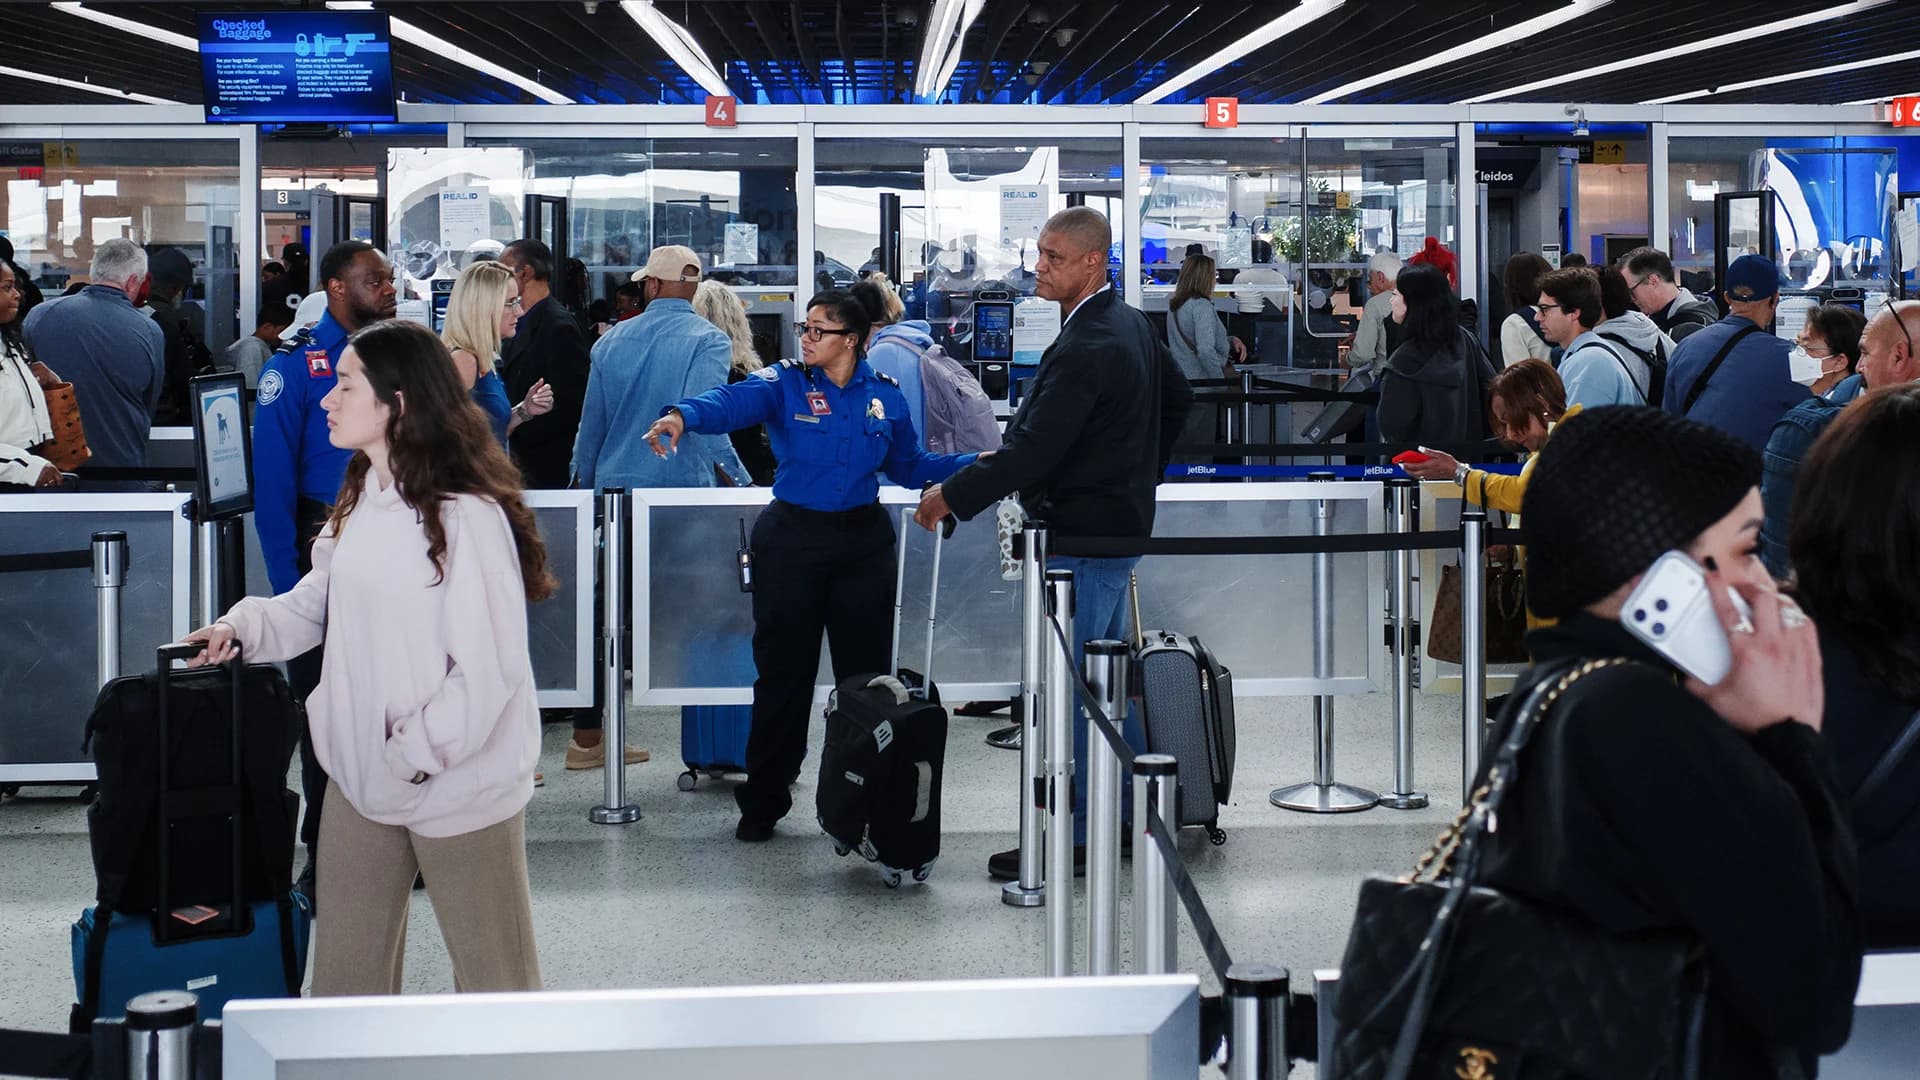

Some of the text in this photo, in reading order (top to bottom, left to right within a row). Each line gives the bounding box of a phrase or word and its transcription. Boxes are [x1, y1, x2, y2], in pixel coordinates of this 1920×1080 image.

[213, 19, 265, 30] Checked
[219, 28, 272, 40] Baggage
[713, 101, 727, 120] 4
[1217, 103, 1230, 122] 5
[1896, 102, 1902, 121] 6
[11, 146, 41, 155] Gates
[1481, 171, 1513, 181] leidos
[280, 192, 286, 203] 3
[1187, 465, 1216, 475] jetBlue
[1364, 466, 1393, 476] jetBlue
